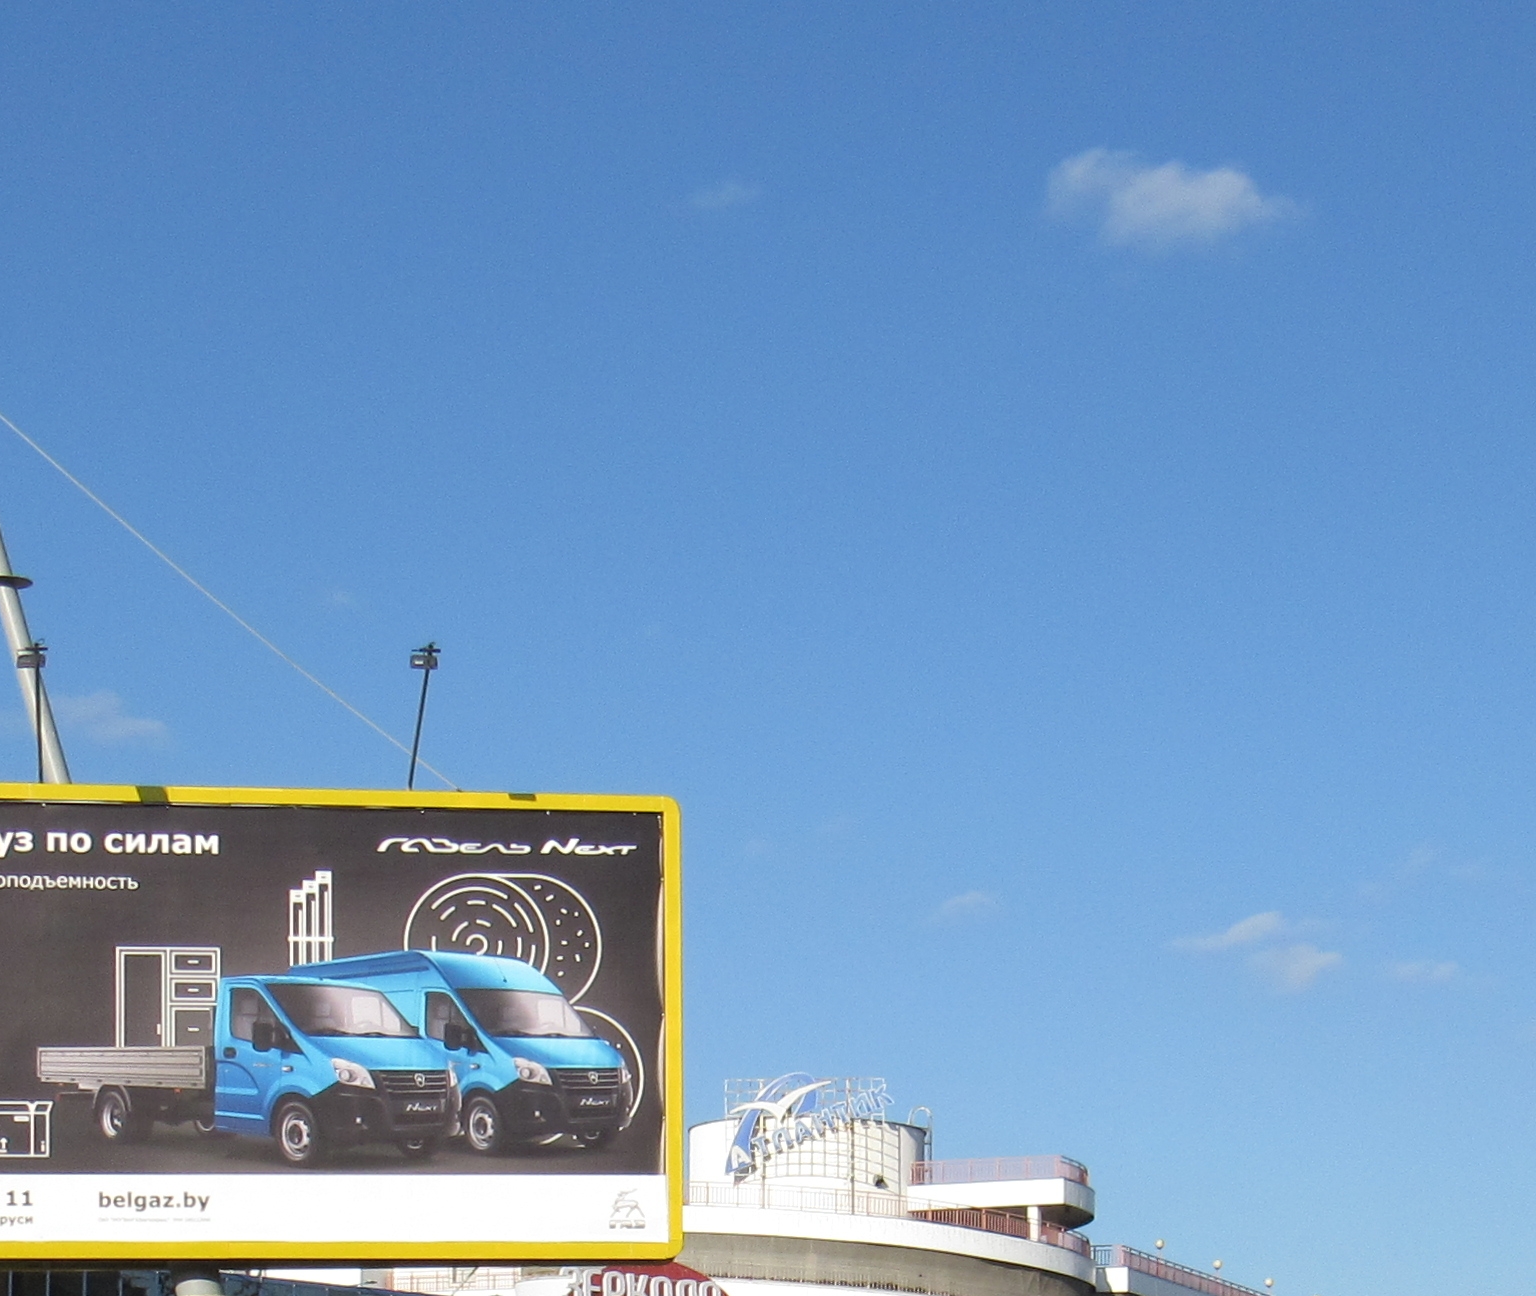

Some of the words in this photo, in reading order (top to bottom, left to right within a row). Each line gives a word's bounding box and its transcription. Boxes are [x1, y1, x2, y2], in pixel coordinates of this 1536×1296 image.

[46, 830, 93, 853] по
[104, 831, 221, 855] силам
[6, 1190, 33, 1206] 11
[98, 1191, 211, 1212] belgaz.by
